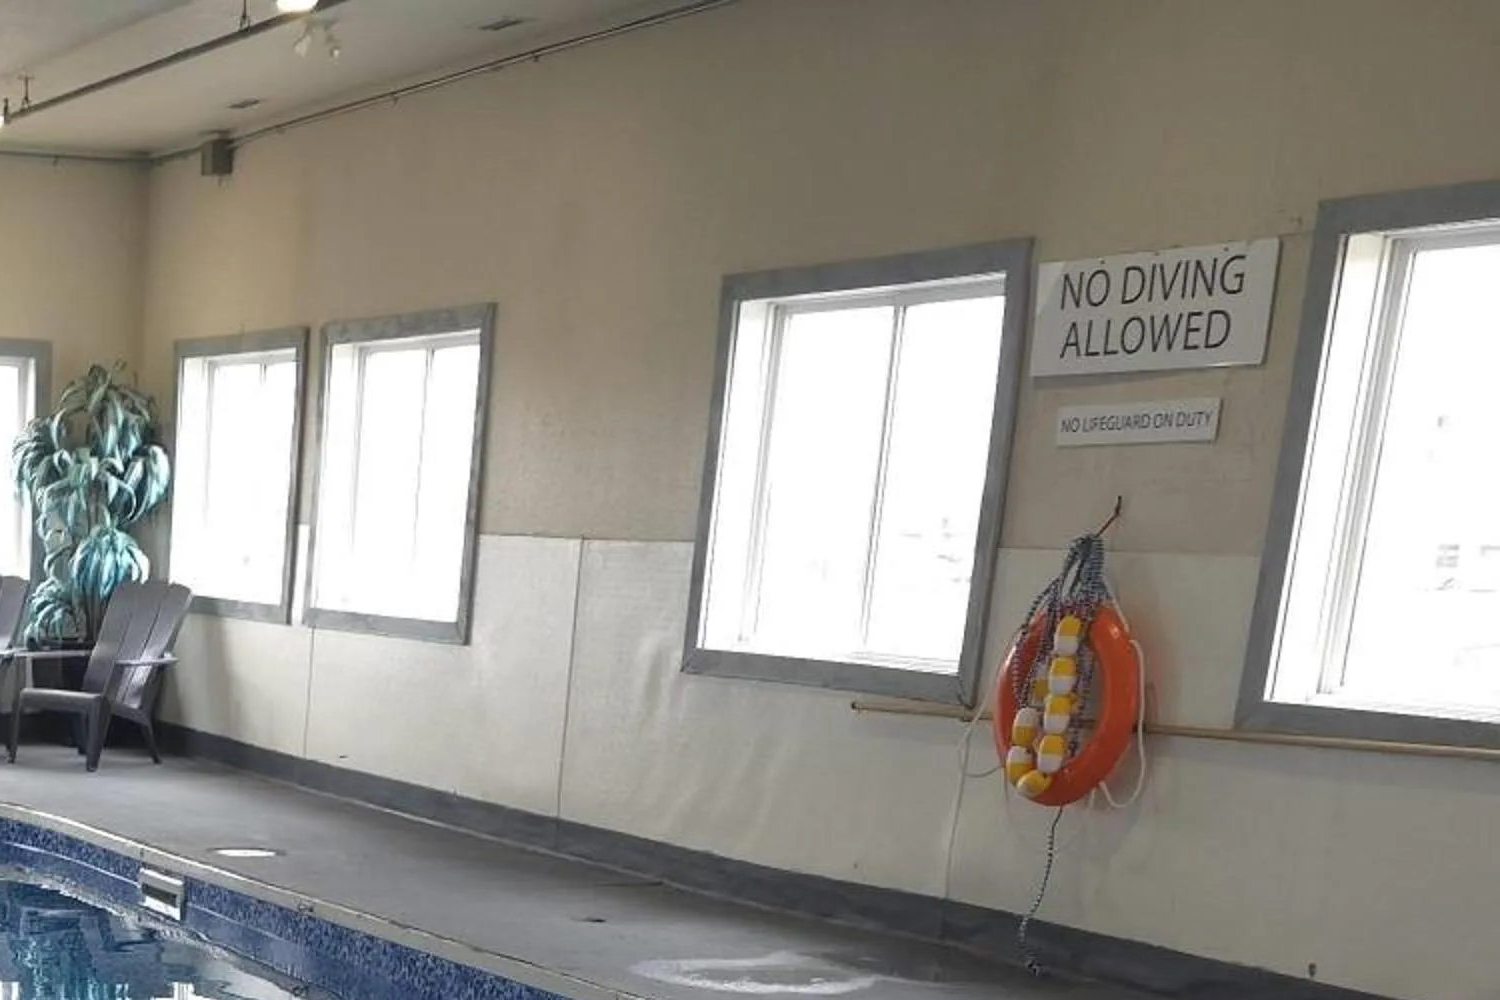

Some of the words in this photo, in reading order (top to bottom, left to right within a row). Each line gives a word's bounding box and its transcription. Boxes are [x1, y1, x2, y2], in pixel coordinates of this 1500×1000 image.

[1060, 268, 1111, 310] NO
[1121, 254, 1247, 305] DIVING
[1059, 309, 1232, 359] ALLOWED
[1060, 416, 1081, 433] NO
[1082, 413, 1151, 432] LIFEGUARD
[1153, 413, 1174, 429] ON
[1175, 410, 1214, 428] DUTY
